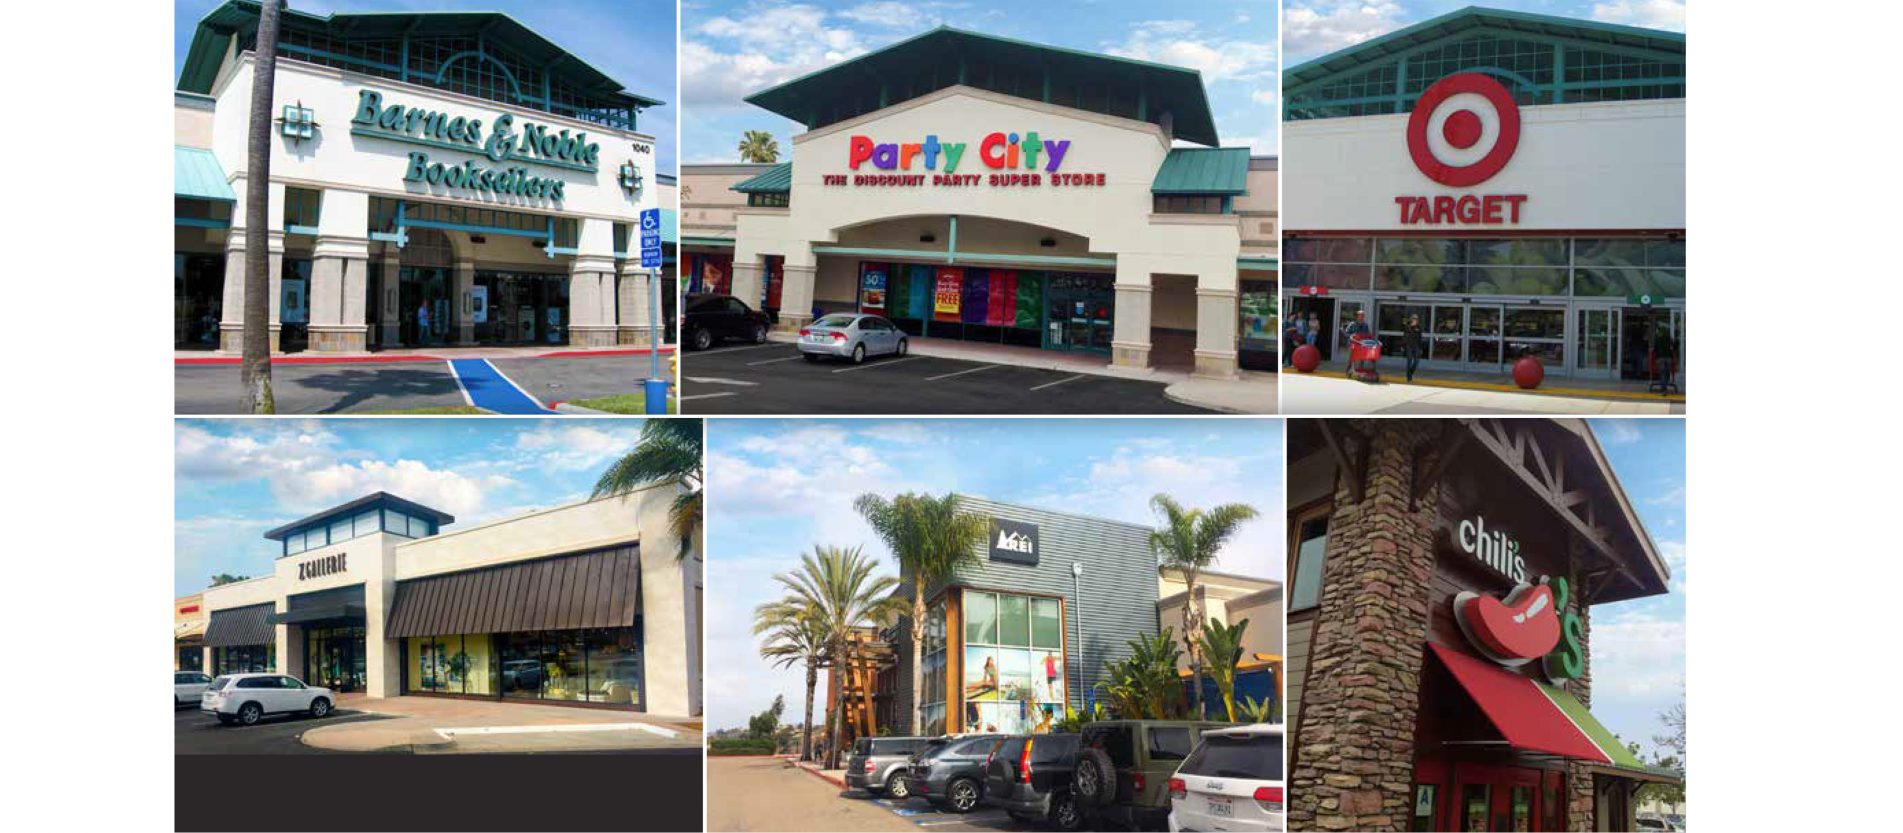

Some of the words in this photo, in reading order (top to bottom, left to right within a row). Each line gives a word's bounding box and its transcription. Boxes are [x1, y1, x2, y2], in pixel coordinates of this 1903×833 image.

[351, 89, 482, 144] Barnes
[484, 112, 518, 161] &
[518, 122, 600, 165] Noble
[632, 143, 650, 154] 1040
[849, 134, 967, 174] Party
[980, 132, 1071, 174] City
[403, 151, 565, 201] Booksellers
[823, 174, 848, 186] THE
[854, 174, 925, 186] DISCOUNT
[933, 174, 982, 186] PARTY
[989, 174, 1042, 186] SUPER
[1050, 173, 1106, 186] STORE
[1394, 194, 1528, 225] TARGET
[936, 293, 960, 305] FREE
